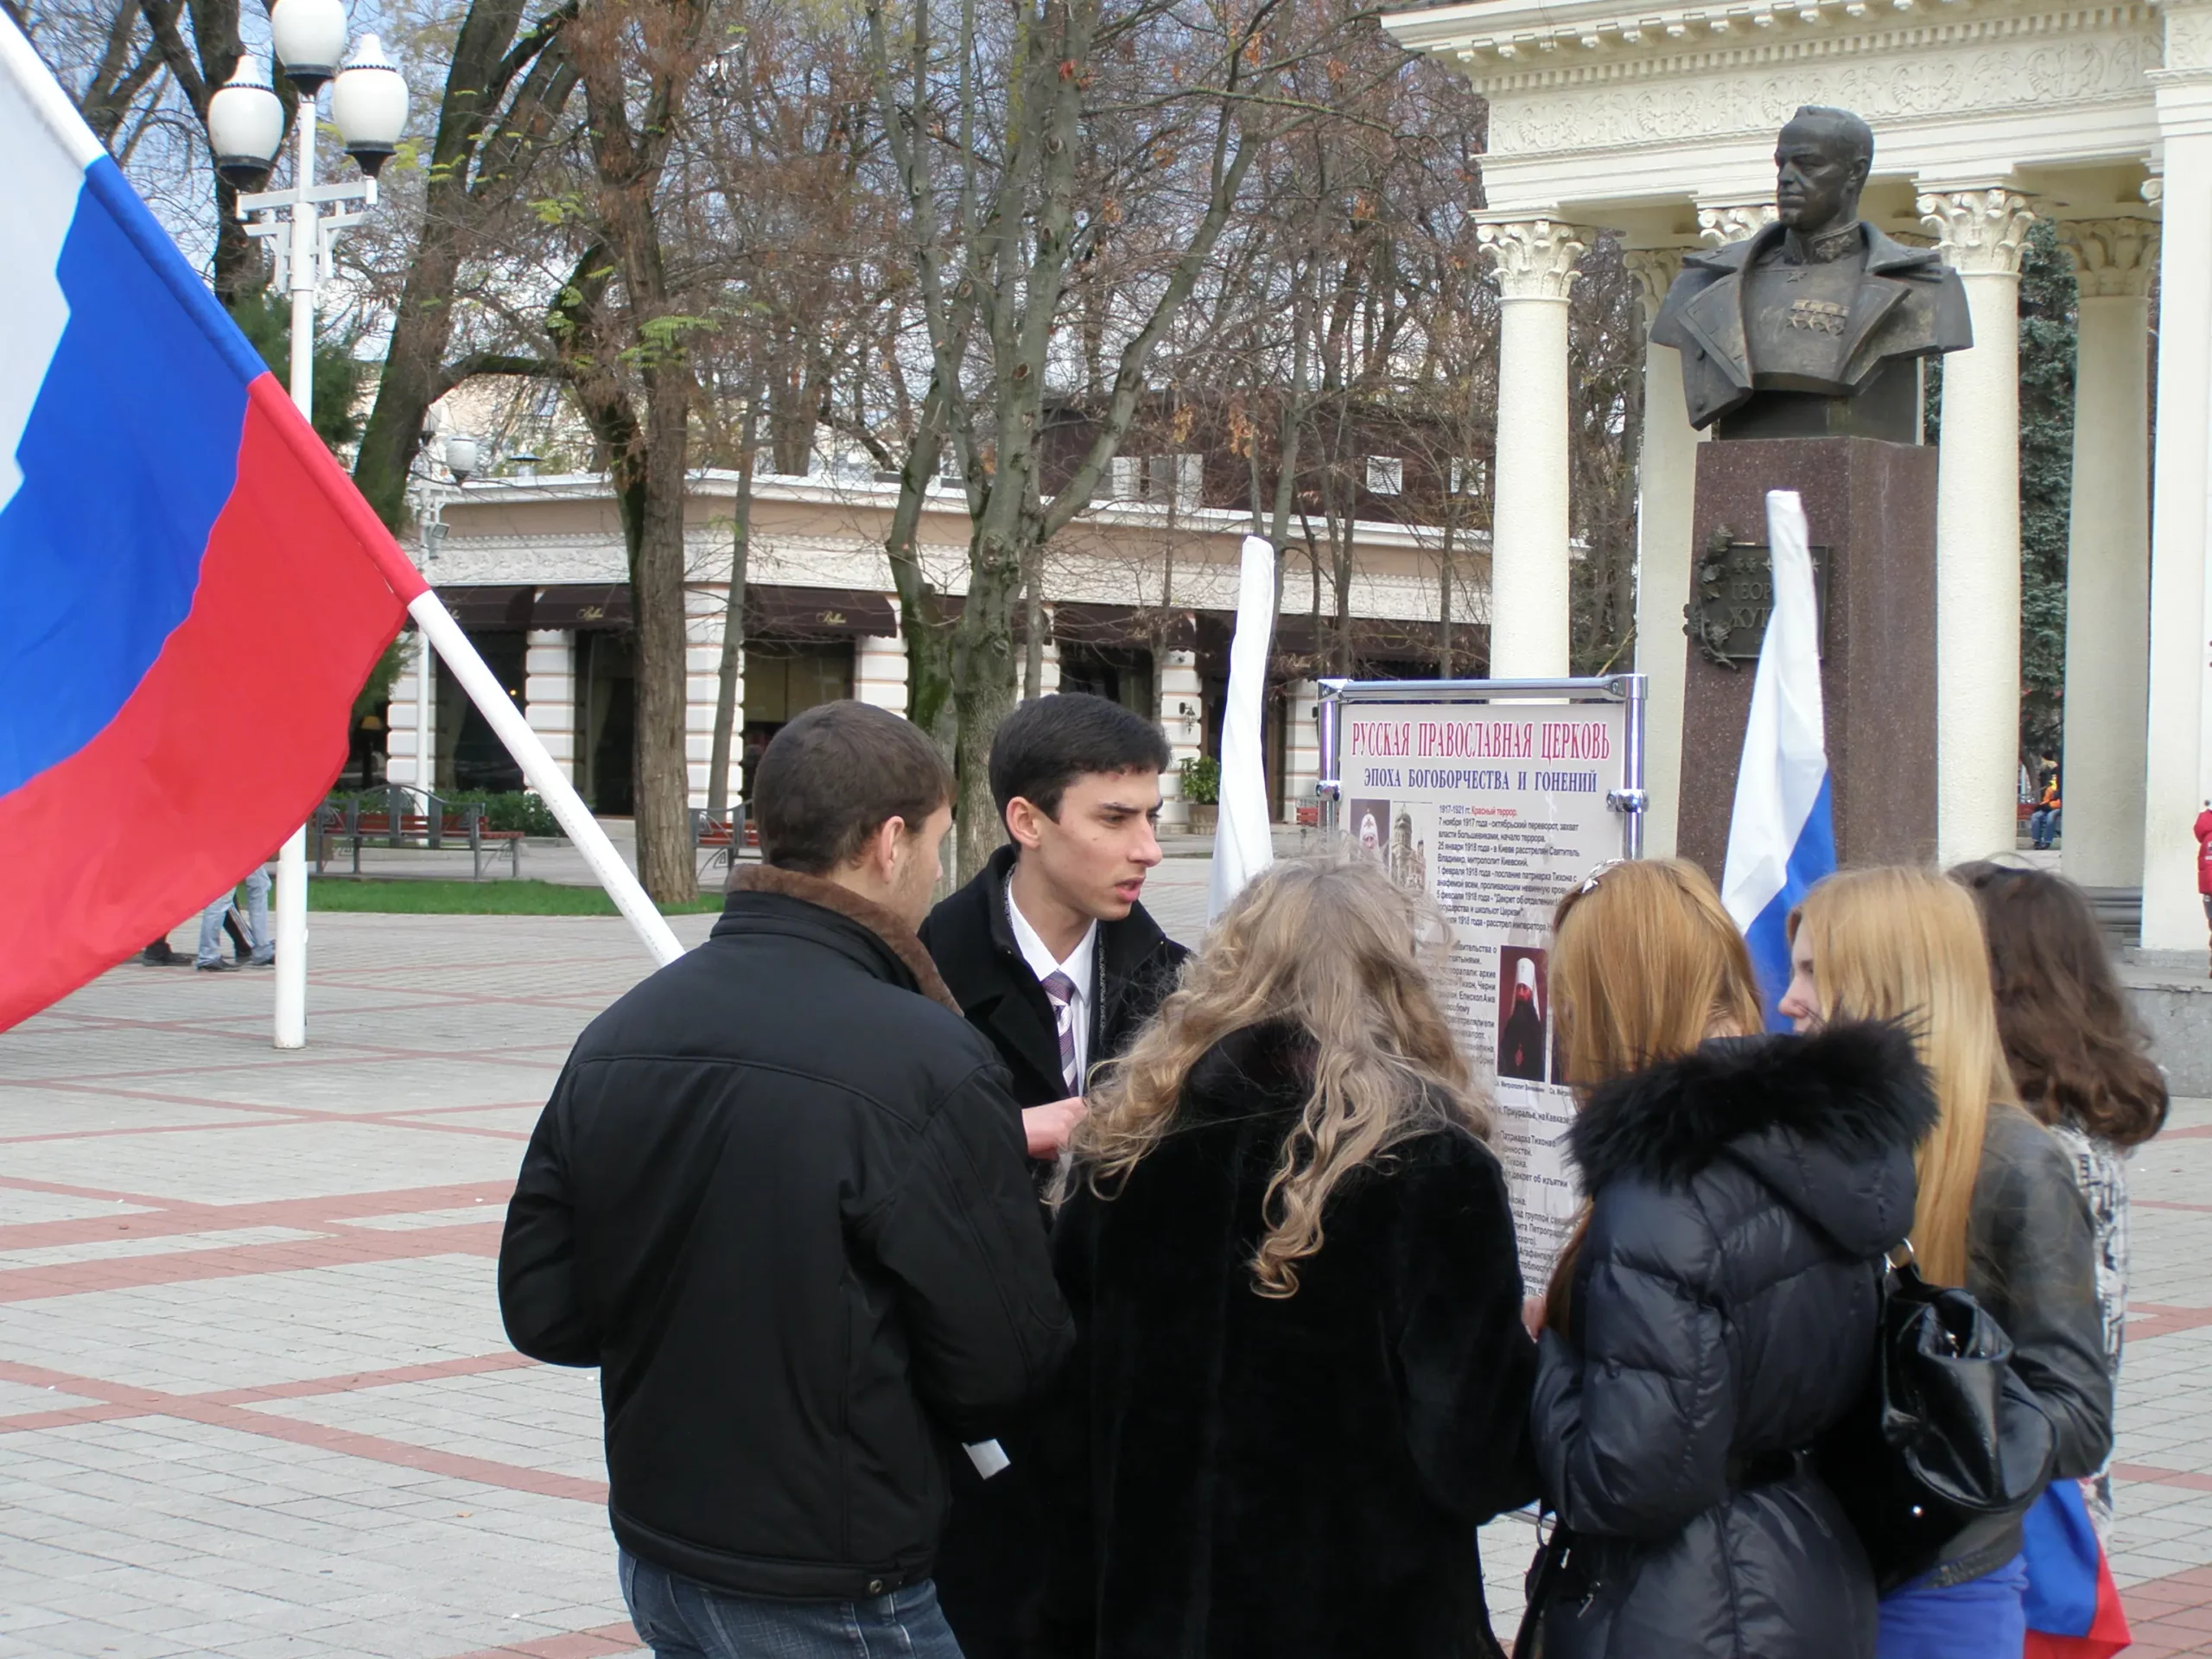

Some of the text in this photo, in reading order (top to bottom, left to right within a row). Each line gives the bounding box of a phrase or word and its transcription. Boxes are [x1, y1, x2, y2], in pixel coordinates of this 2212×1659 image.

[1732, 582, 1773, 601] ГЕОР
[1351, 722, 1610, 766] РУССКАЯ ПРАВОСЛАВНАЯ ЦЕРКОВЬ
[1364, 768, 1598, 792] ЭПОХА БОГОБОРЧЕСТВА И ГОНЕНИЙ
[1440, 805, 1464, 815] 1917-1921
[1471, 806, 1496, 816] Красный
[1439, 817, 1442, 825] 7
[1443, 817, 1462, 828] ноября
[1463, 818, 1475, 827] 1917
[1475, 819, 1488, 828] года
[1501, 833, 1521, 842] начало
[1438, 841, 1444, 850] 25
[1445, 842, 1464, 852] января
[1465, 842, 1478, 852] 1918
[1478, 844, 1490, 853] года
[1497, 845, 1515, 854] Киеве
[1549, 847, 1580, 857] Святитель
[1441, 867, 1465, 875] февраля
[1466, 868, 1478, 876] 1918
[1495, 870, 1521, 879] послание
[1522, 872, 1551, 881] патриарха
[1553, 872, 1573, 882] Тихона
[1437, 879, 1464, 888] анафемой
[1437, 890, 1440, 899] 5
[1465, 892, 1477, 900] 1918
[1439, 904, 1469, 913] осударства
